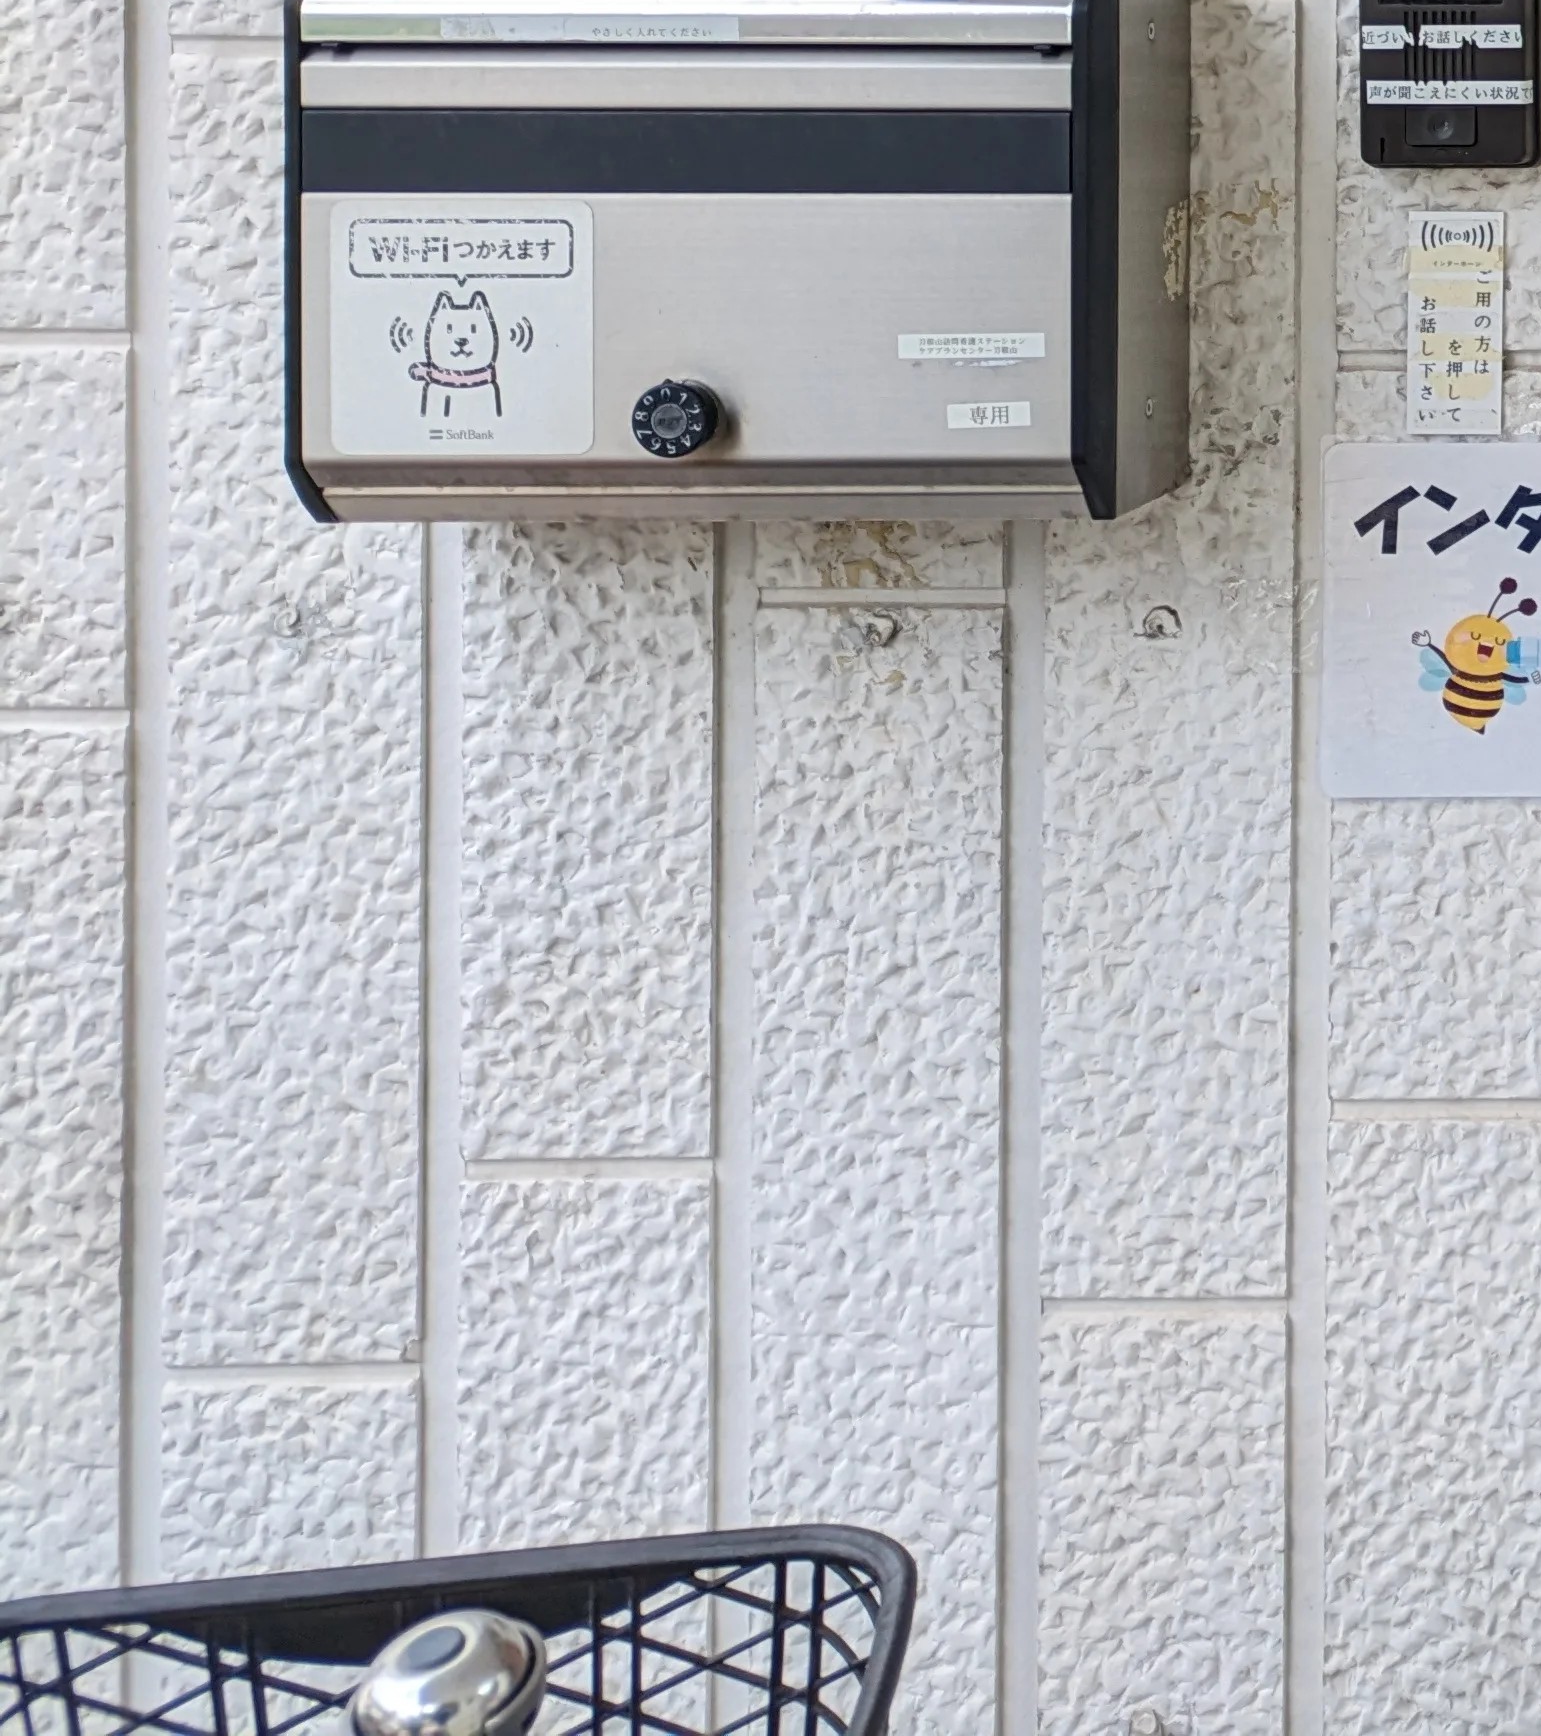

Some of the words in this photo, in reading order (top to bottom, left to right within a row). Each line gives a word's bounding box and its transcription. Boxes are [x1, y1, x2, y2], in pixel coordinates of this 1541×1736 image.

[592, 27, 713, 38] やさしく入れてください
[1418, 296, 1437, 422] お話し下さい
[969, 405, 1009, 425] 専用
[445, 429, 494, 441] SoftBank
